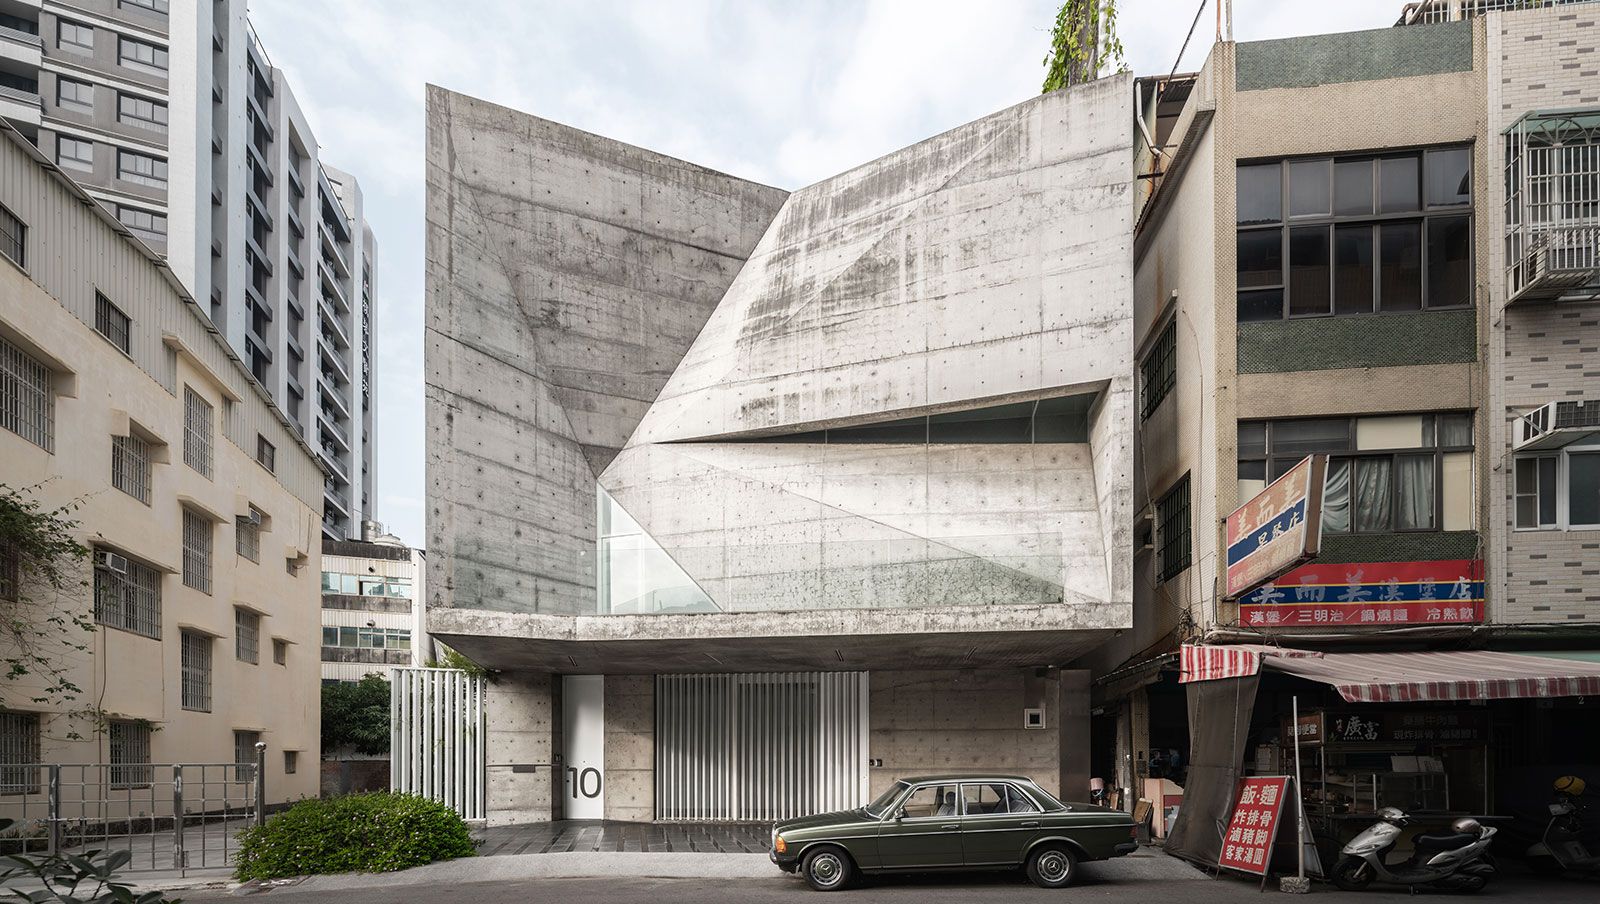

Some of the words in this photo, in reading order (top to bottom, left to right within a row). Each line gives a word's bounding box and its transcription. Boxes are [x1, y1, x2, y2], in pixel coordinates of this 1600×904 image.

[1426, 606, 1474, 621] 冷熱飲
[568, 767, 602, 799] 10
[1233, 808, 1273, 827] 炸排骨
[1225, 844, 1265, 866] 客家湯圓
